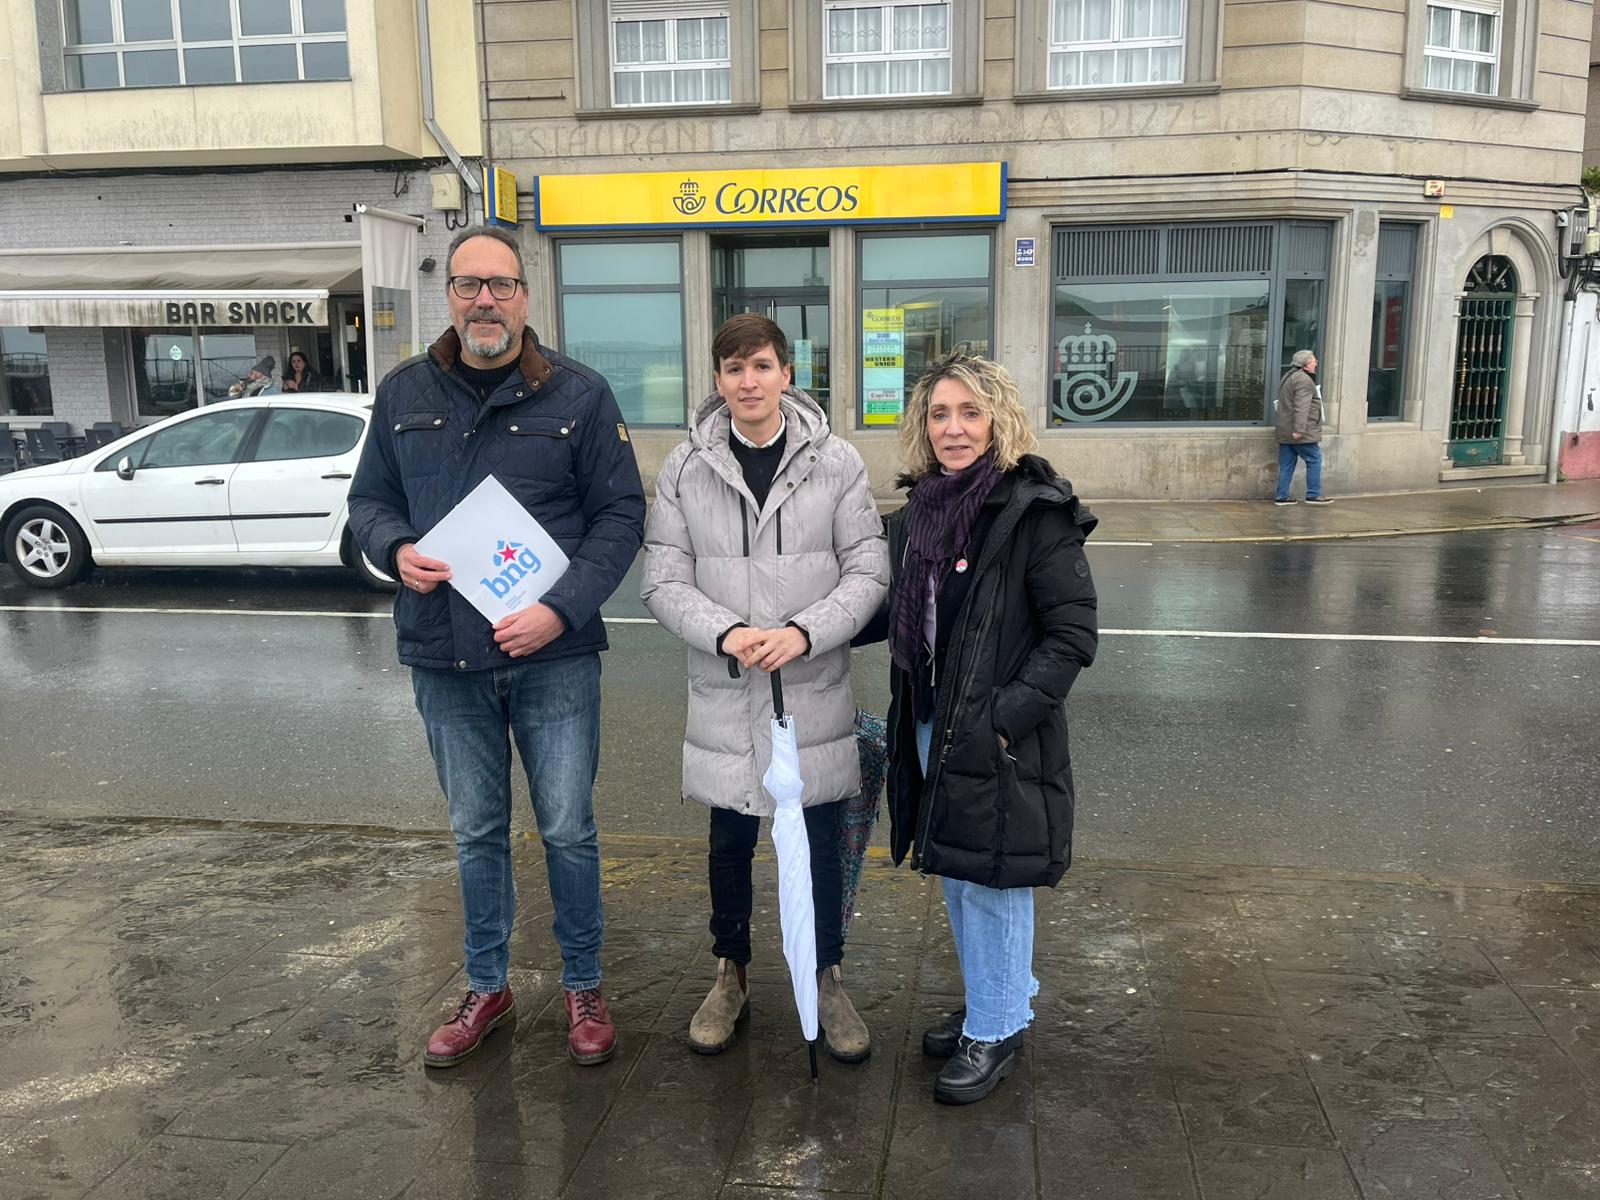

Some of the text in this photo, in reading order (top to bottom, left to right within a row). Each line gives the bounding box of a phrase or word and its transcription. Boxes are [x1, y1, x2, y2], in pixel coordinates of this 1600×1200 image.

[716, 182, 858, 214] CORREOS
[166, 302, 313, 324] BAR SNACK
[480, 547, 542, 599] bng
